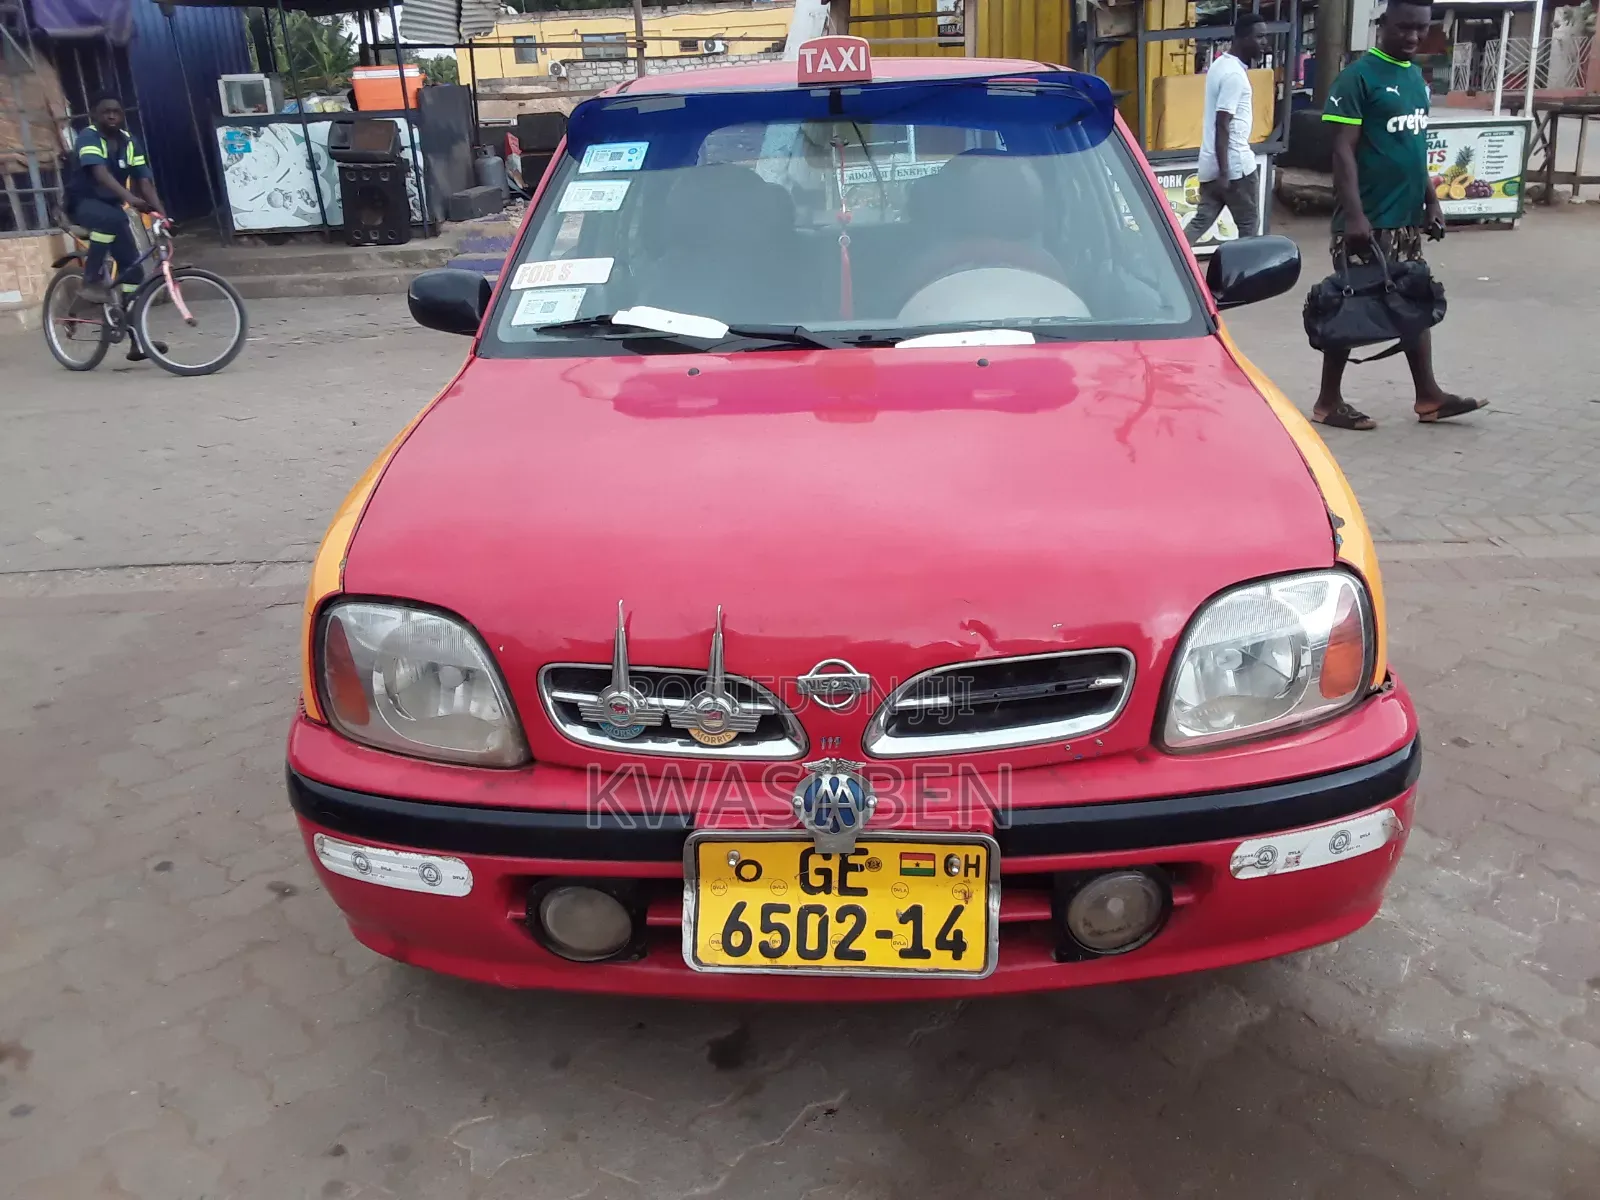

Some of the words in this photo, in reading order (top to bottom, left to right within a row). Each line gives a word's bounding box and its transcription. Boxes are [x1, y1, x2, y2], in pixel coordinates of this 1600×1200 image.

[799, 46, 866, 74] TAXI
[1158, 174, 1182, 188] PORK
[517, 264, 556, 285] FOR
[806, 678, 862, 691] NISSAN
[605, 725, 641, 737] MORRIS
[694, 730, 732, 745] MORRIS
[800, 847, 869, 897] GE
[721, 901, 967, 960] 6502-14
